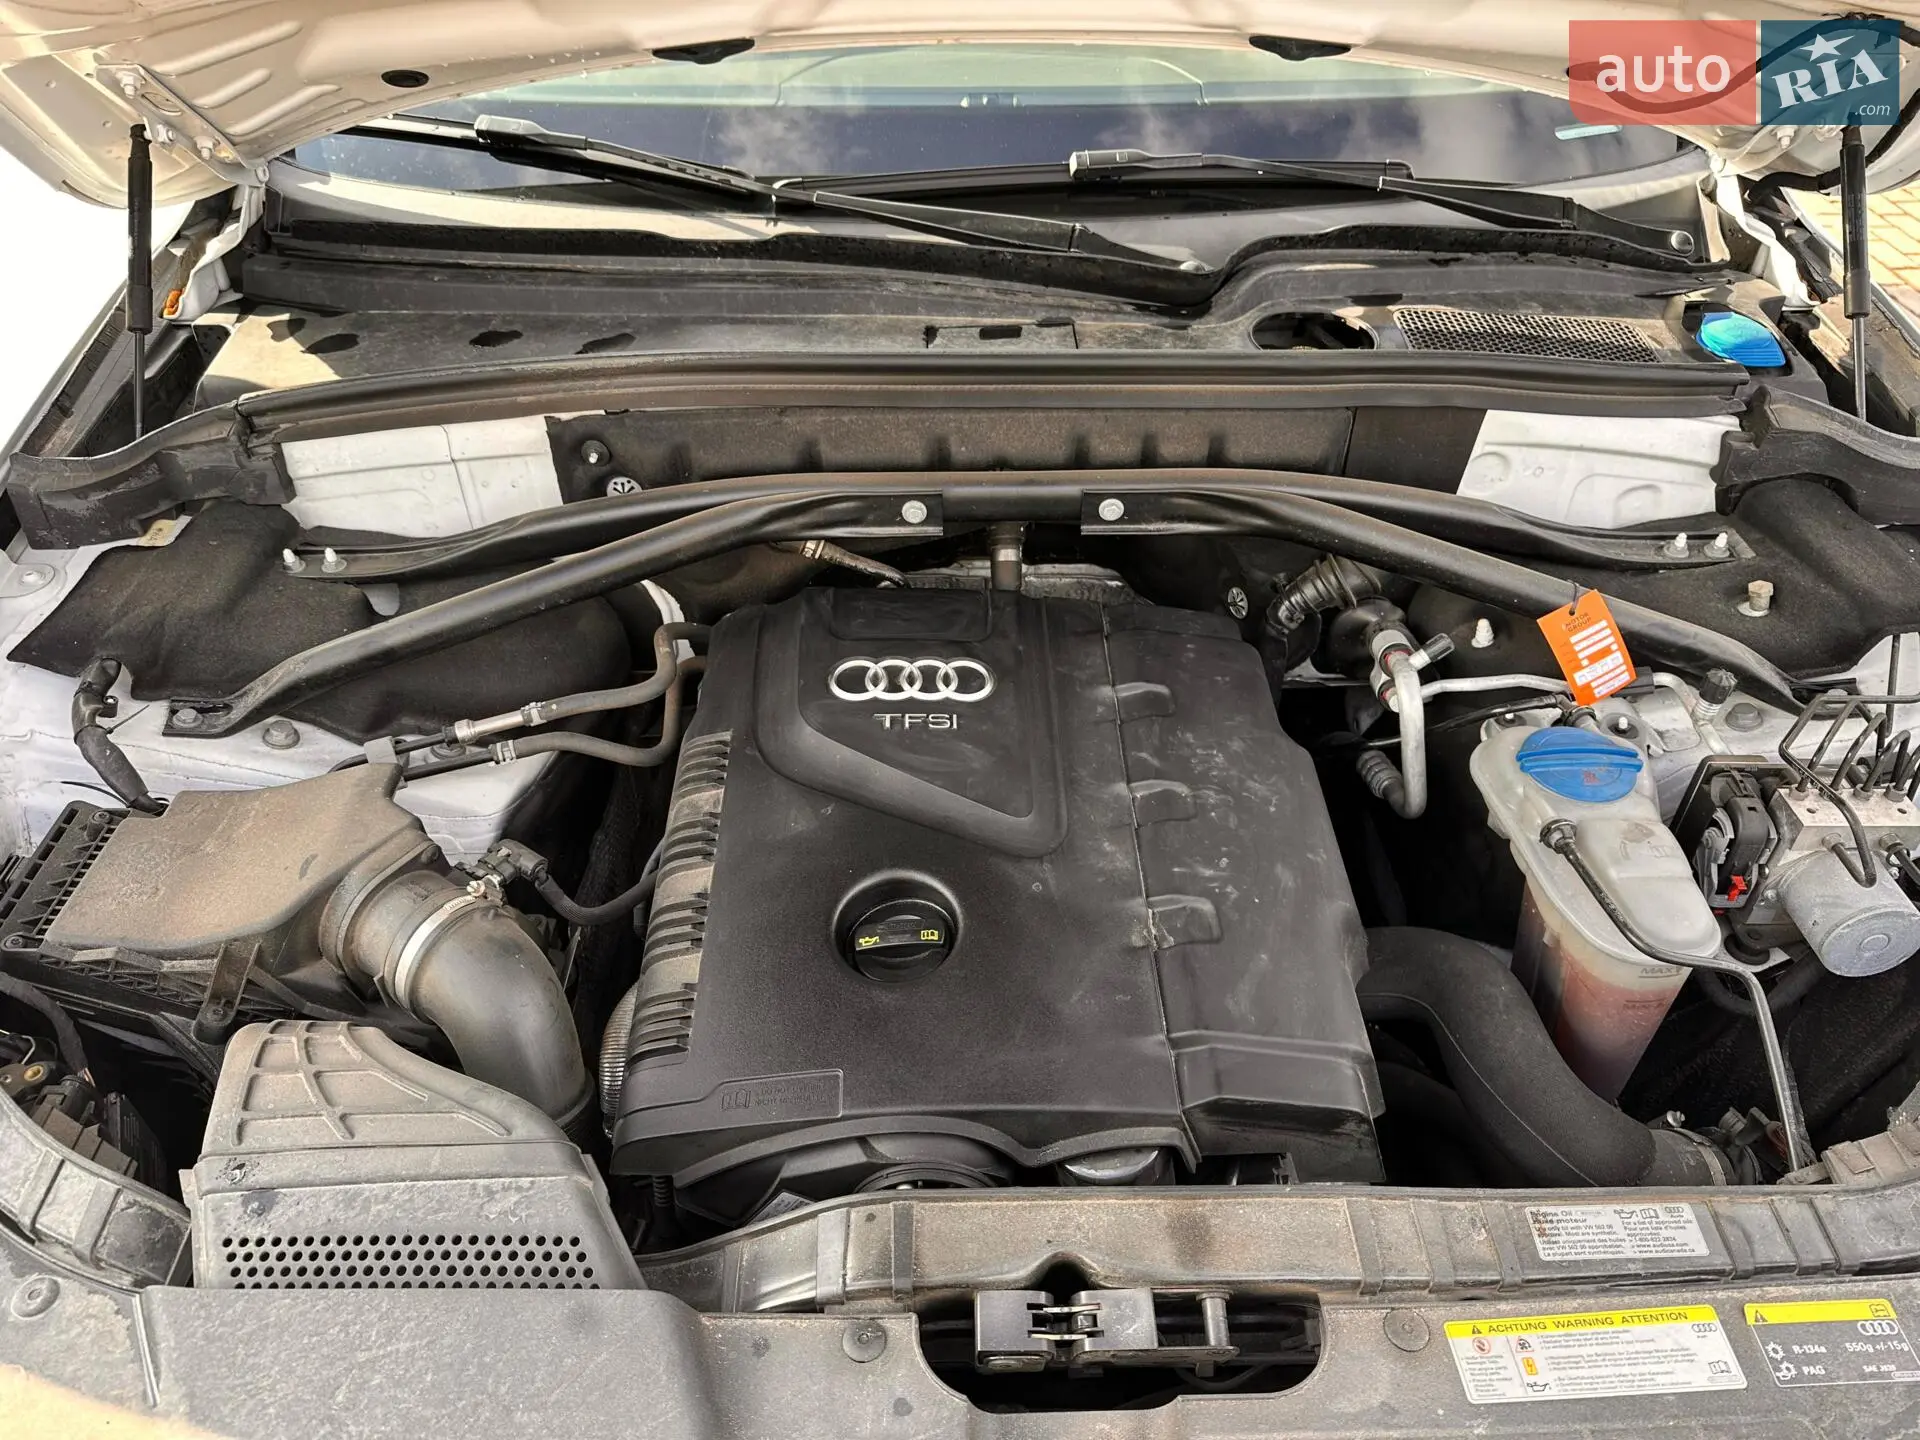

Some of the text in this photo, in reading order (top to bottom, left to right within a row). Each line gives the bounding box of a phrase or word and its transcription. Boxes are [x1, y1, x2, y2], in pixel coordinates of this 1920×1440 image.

[1565, 612, 1590, 628] MOTOR
[1568, 616, 1592, 633] GROUP
[873, 713, 958, 730] TFSI
[1557, 1217, 1588, 1225] moteur
[1488, 1320, 1548, 1335] ACHTUNG
[1553, 1315, 1614, 1330] WARNING
[1620, 1311, 1689, 1325] ATTENTION
[1791, 1344, 1828, 1354] R-134a
[1845, 1342, 1874, 1353] 550g
[1802, 1365, 1826, 1376] PAG
